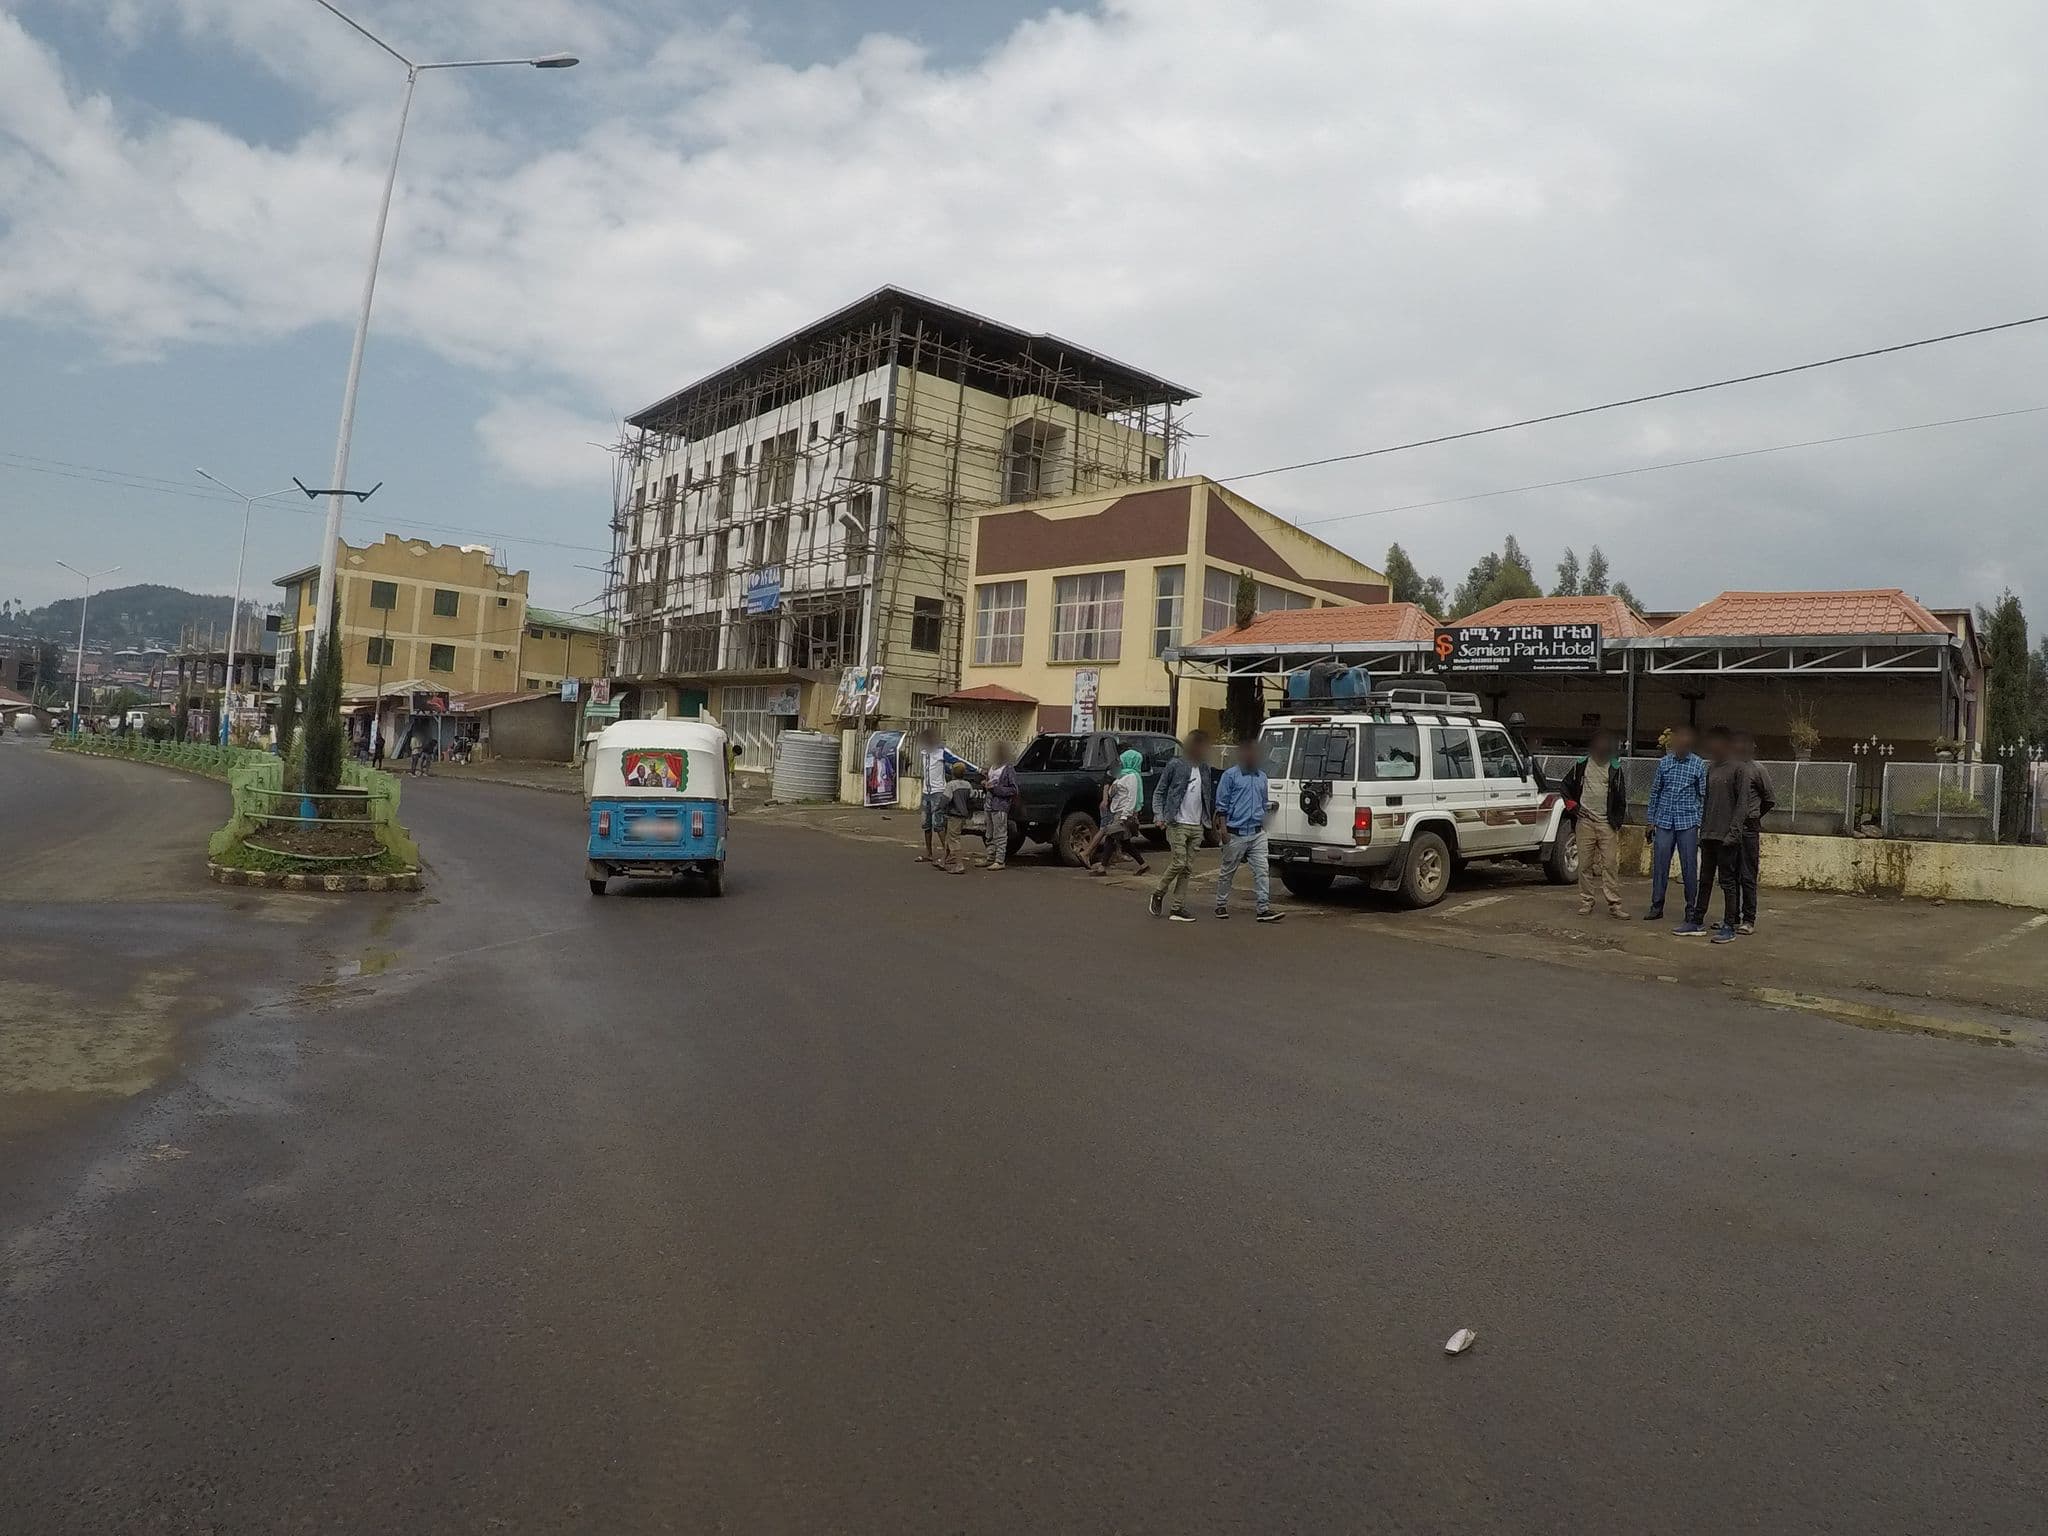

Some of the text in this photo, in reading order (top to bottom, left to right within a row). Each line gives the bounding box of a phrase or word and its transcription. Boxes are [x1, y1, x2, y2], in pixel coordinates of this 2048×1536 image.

[1458, 641, 1595, 656] Semien Park Hotel
